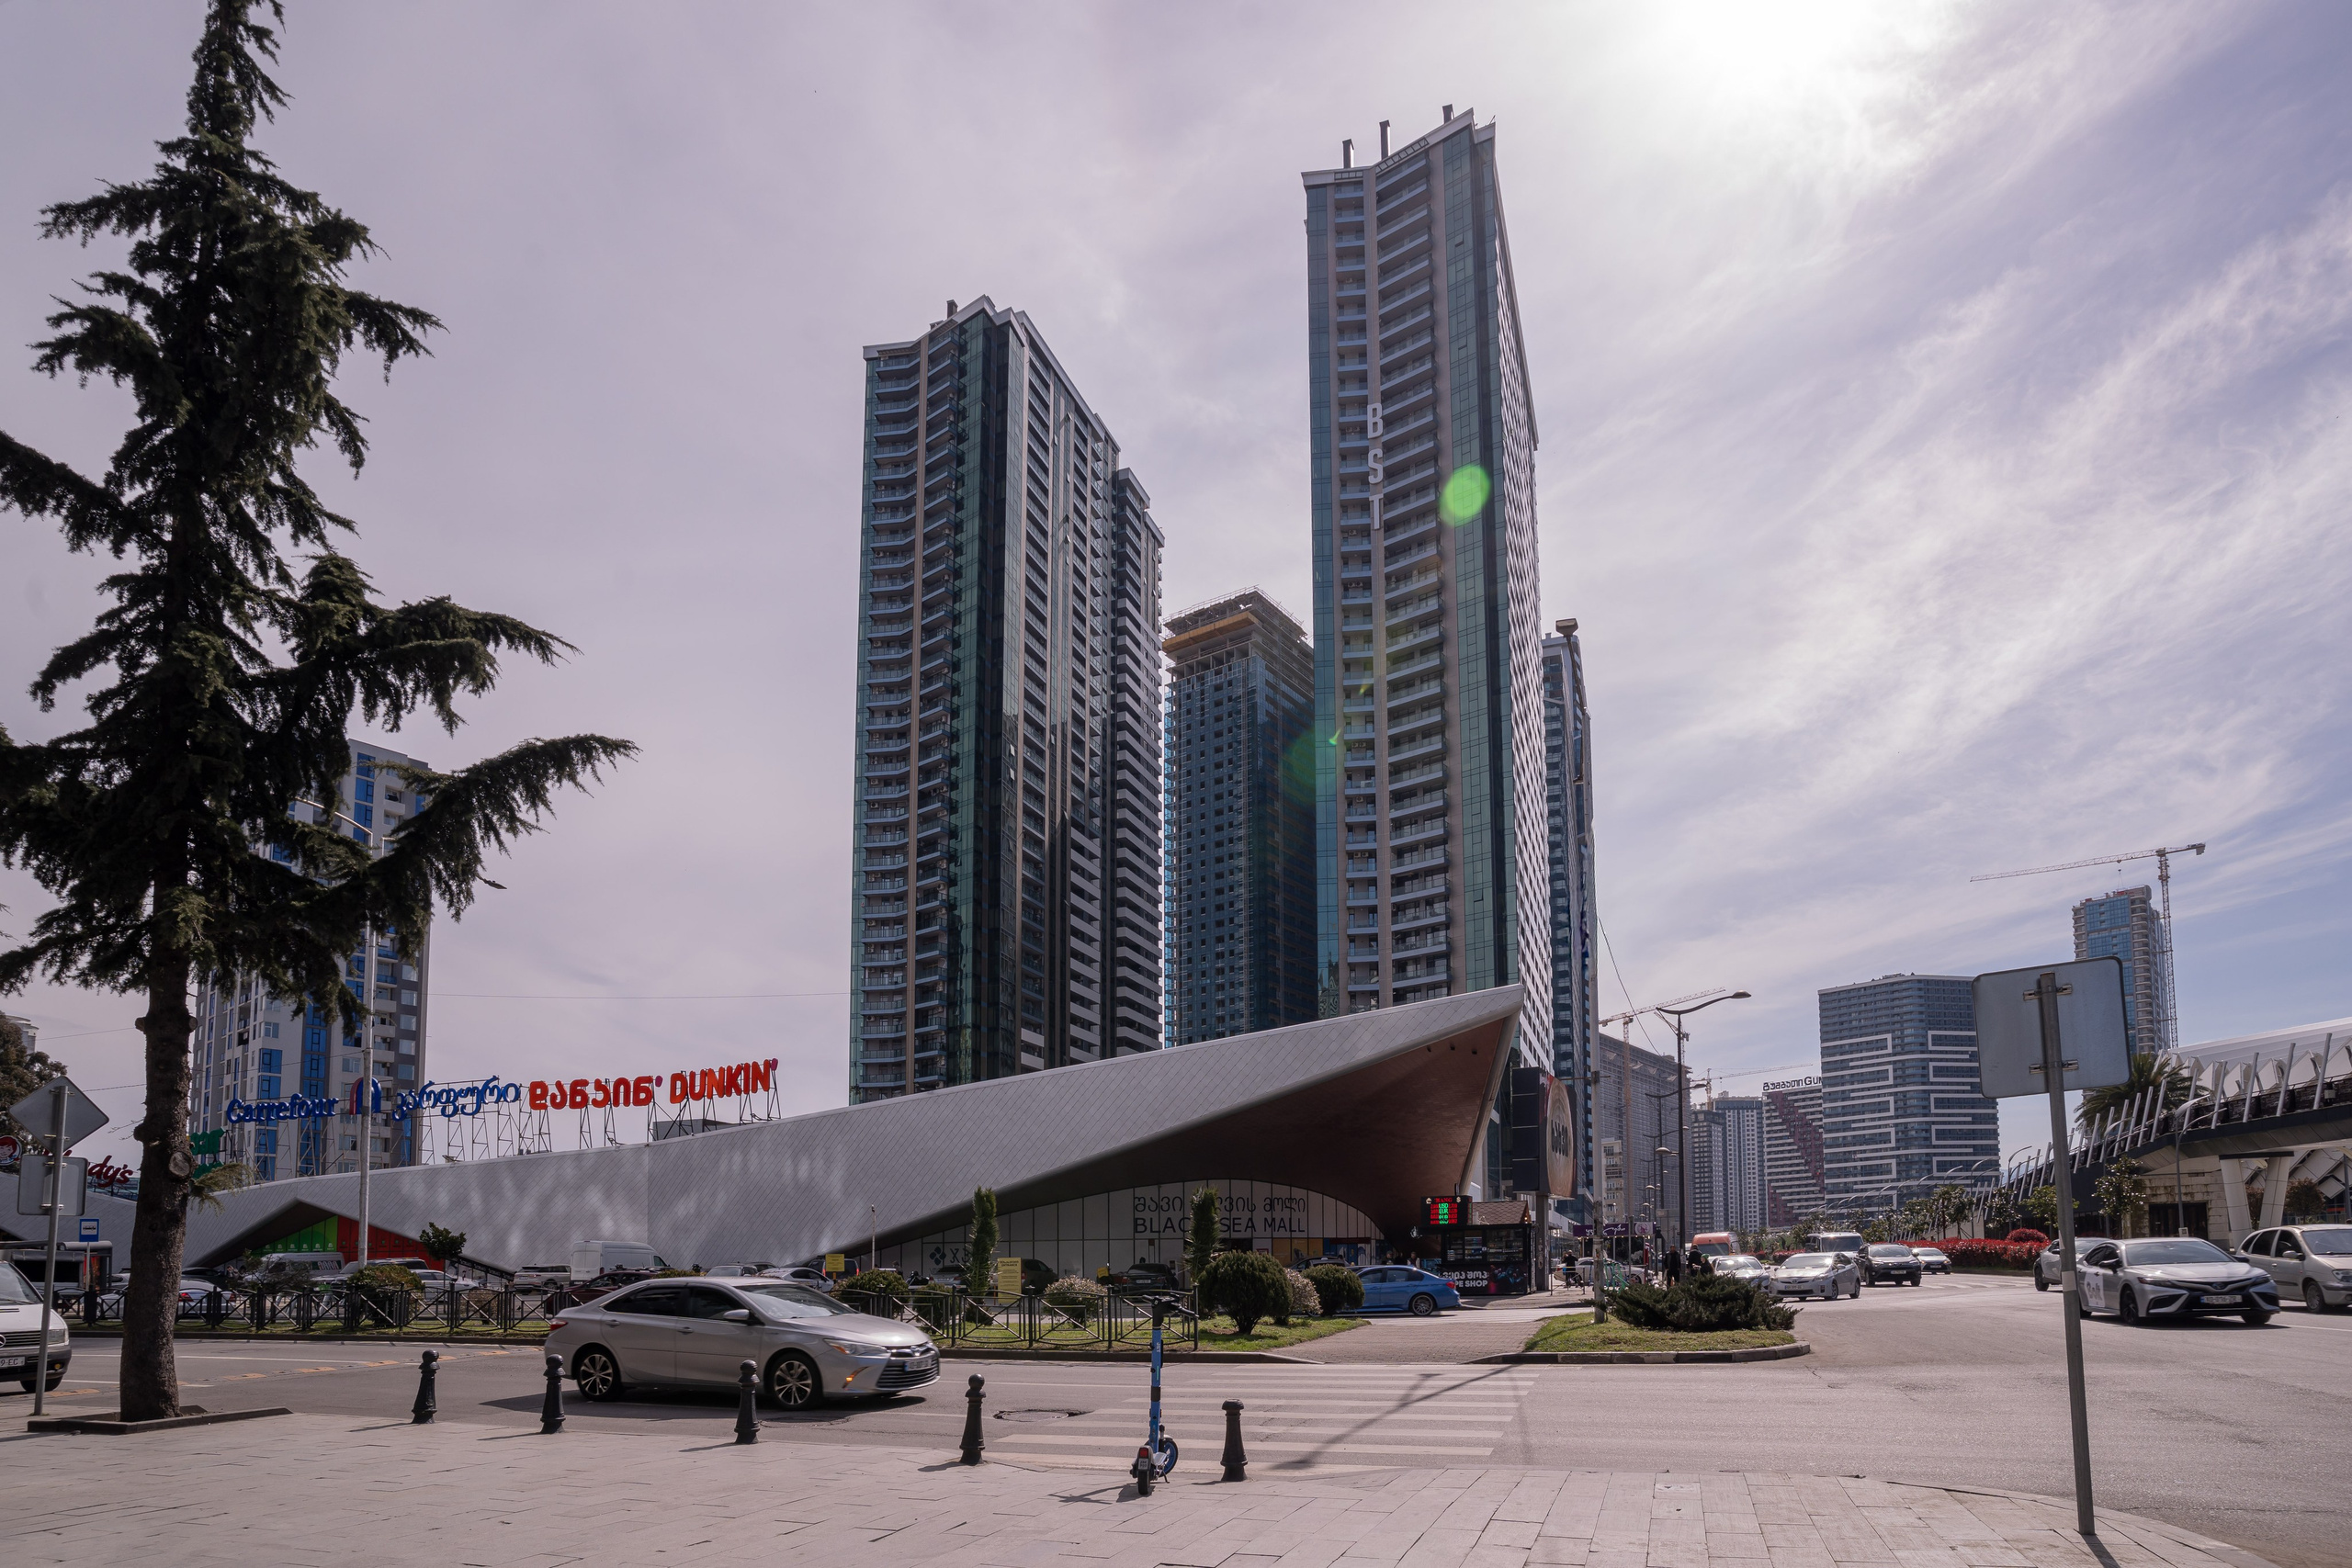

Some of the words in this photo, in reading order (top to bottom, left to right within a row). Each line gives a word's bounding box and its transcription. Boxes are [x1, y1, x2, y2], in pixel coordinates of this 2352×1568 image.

[1367, 402, 1384, 530] BST
[669, 1057, 778, 1105] DUNKIN'
[226, 1093, 339, 1124] Carrefour
[1134, 1196, 1182, 1213] შავი
[1214, 1196, 1256, 1213] ვის
[1263, 1196, 1306, 1213] მოლი
[1135, 1217, 1192, 1234] BLAC
[1219, 1217, 1257, 1233] SEA
[1263, 1217, 1306, 1233] MALL
